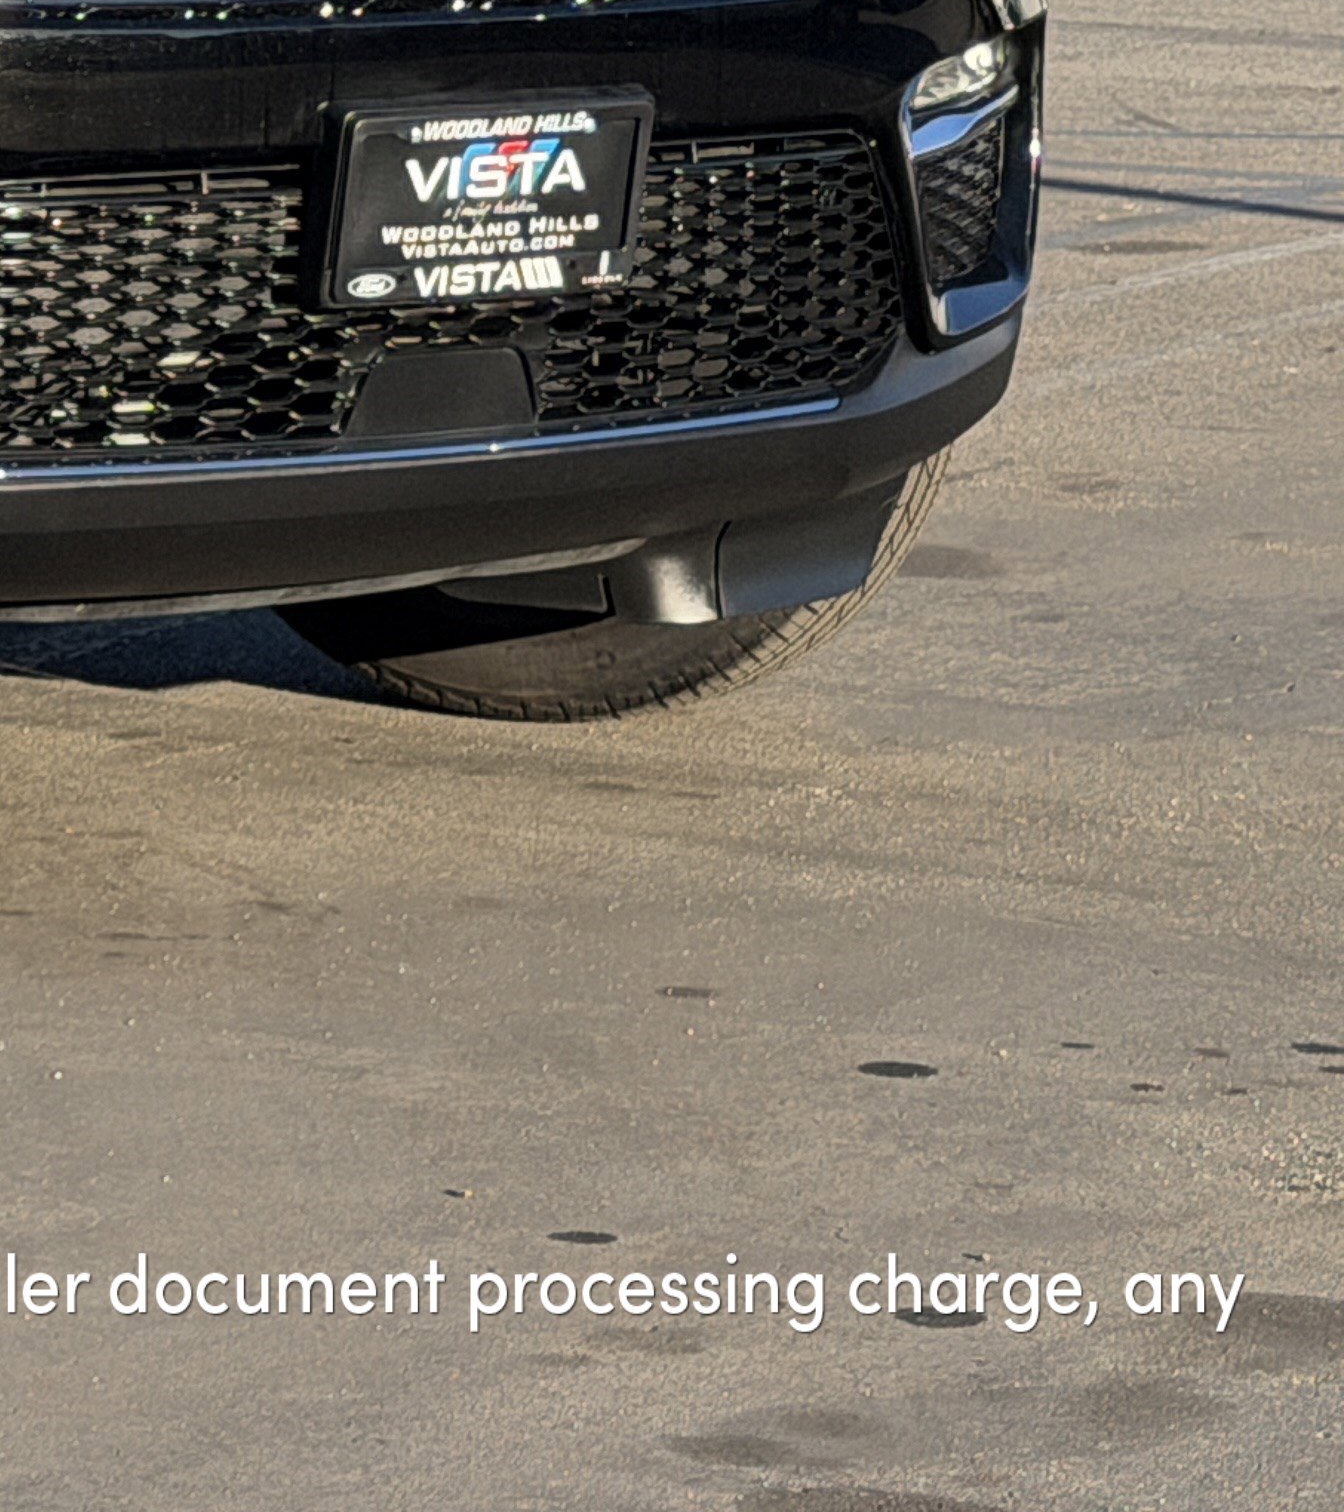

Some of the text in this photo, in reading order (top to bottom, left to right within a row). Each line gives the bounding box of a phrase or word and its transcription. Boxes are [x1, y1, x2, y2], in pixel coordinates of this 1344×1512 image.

[424, 111, 587, 141] WOODLAND HILLS
[405, 148, 586, 202] VISTA
[382, 213, 599, 245] WOODLAND HILLS
[414, 260, 522, 299] VISTA
